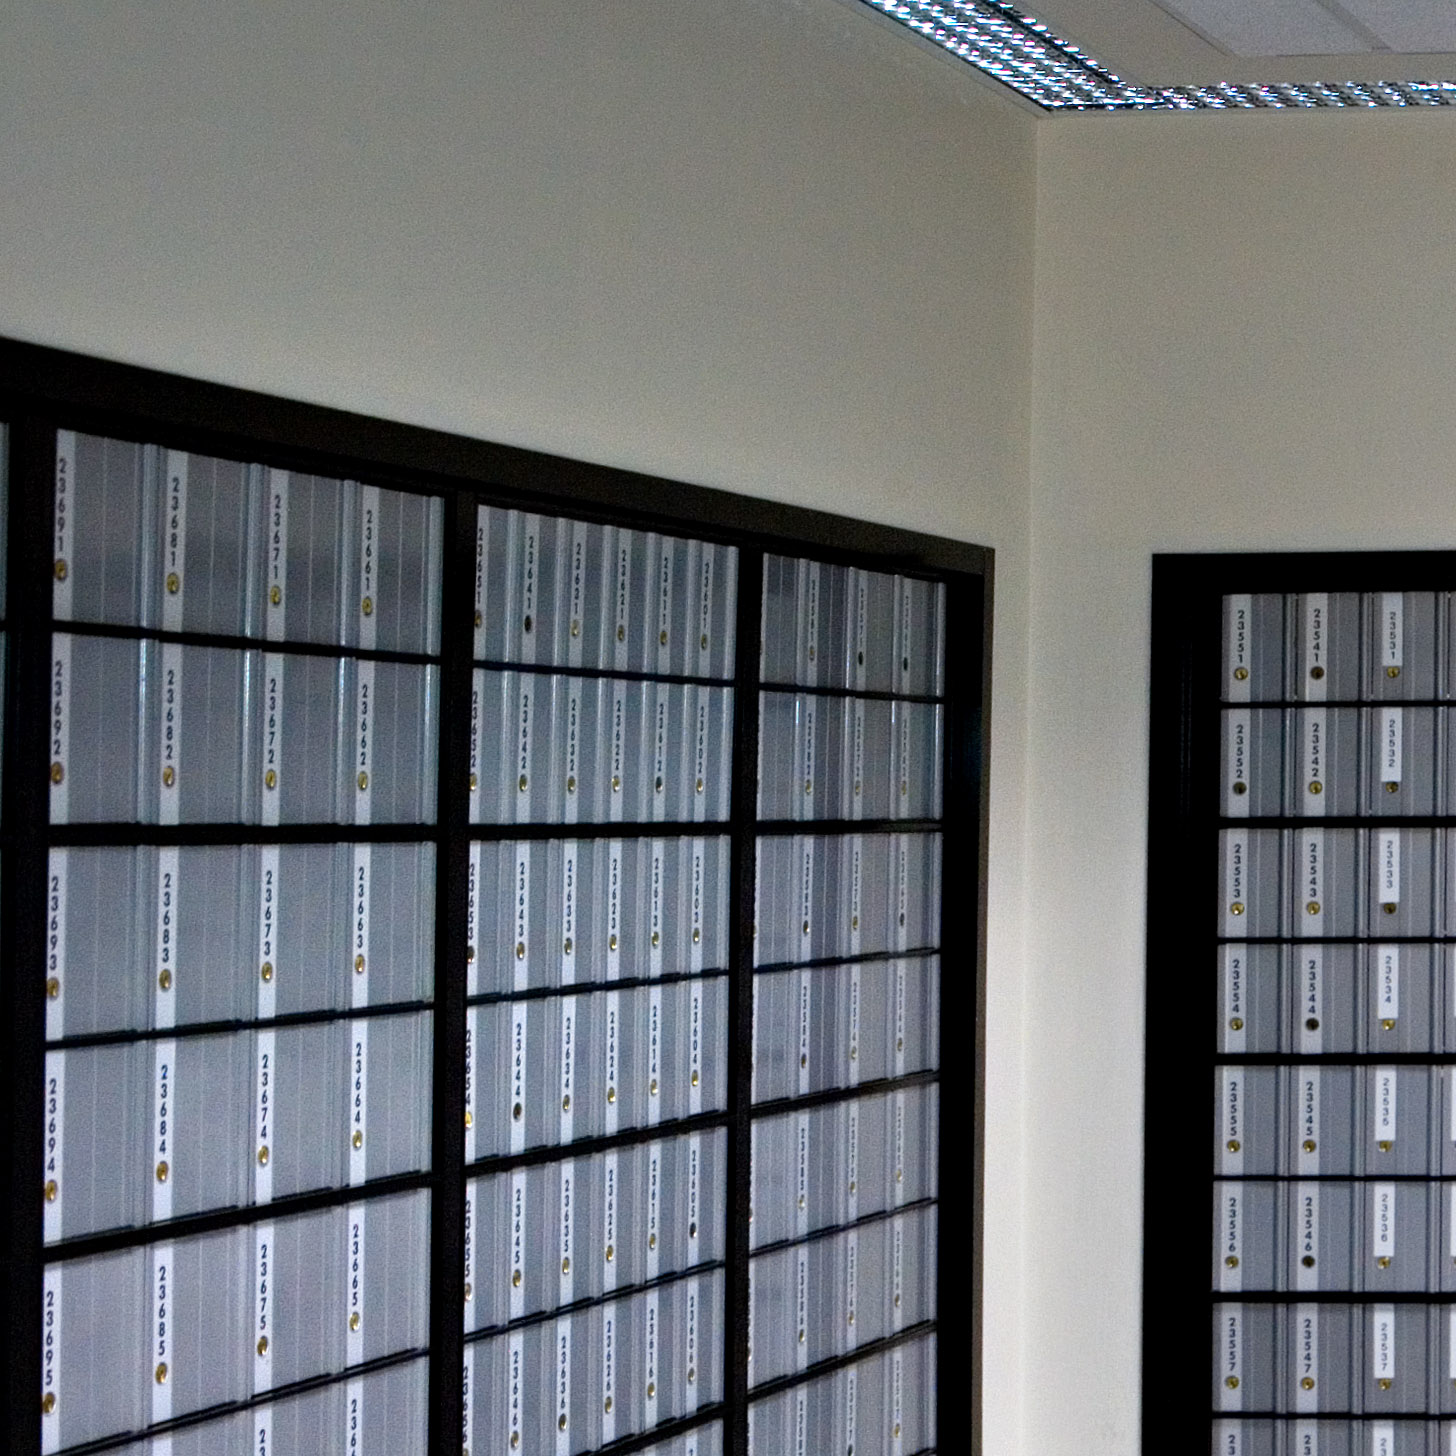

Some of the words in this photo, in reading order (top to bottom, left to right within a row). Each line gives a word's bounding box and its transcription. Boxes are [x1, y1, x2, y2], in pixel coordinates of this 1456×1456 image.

[56, 458, 68, 553] 23691
[170, 477, 180, 566] 23681
[272, 494, 283, 580] 23671
[364, 510, 374, 591] 23661
[1235, 610, 1246, 663] 23551
[52, 661, 64, 756] 23692
[165, 669, 175, 760] 23682
[267, 678, 277, 764] 23672
[359, 684, 369, 766] 23662
[1310, 723, 1321, 777] 23542
[263, 870, 273, 956] 23673
[356, 866, 366, 949] 23663
[1233, 844, 1244, 898] 23553
[49, 876, 59, 971] 23693
[161, 872, 172, 963] 23683
[1307, 960, 1318, 1014] 23544
[47, 1078, 58, 1173] 23694
[159, 1065, 169, 1155] 23684
[260, 1054, 270, 1140] 23674
[354, 1042, 363, 1124] 23664
[1228, 1081, 1239, 1136] 23555
[348, 1224, 360, 1306] 23665
[1302, 1197, 1313, 1251] 23546
[157, 1266, 167, 1357] 23685
[258, 1244, 269, 1331] 23675
[44, 1291, 55, 1386] 23695
[1227, 1317, 1238, 1371] 23557
